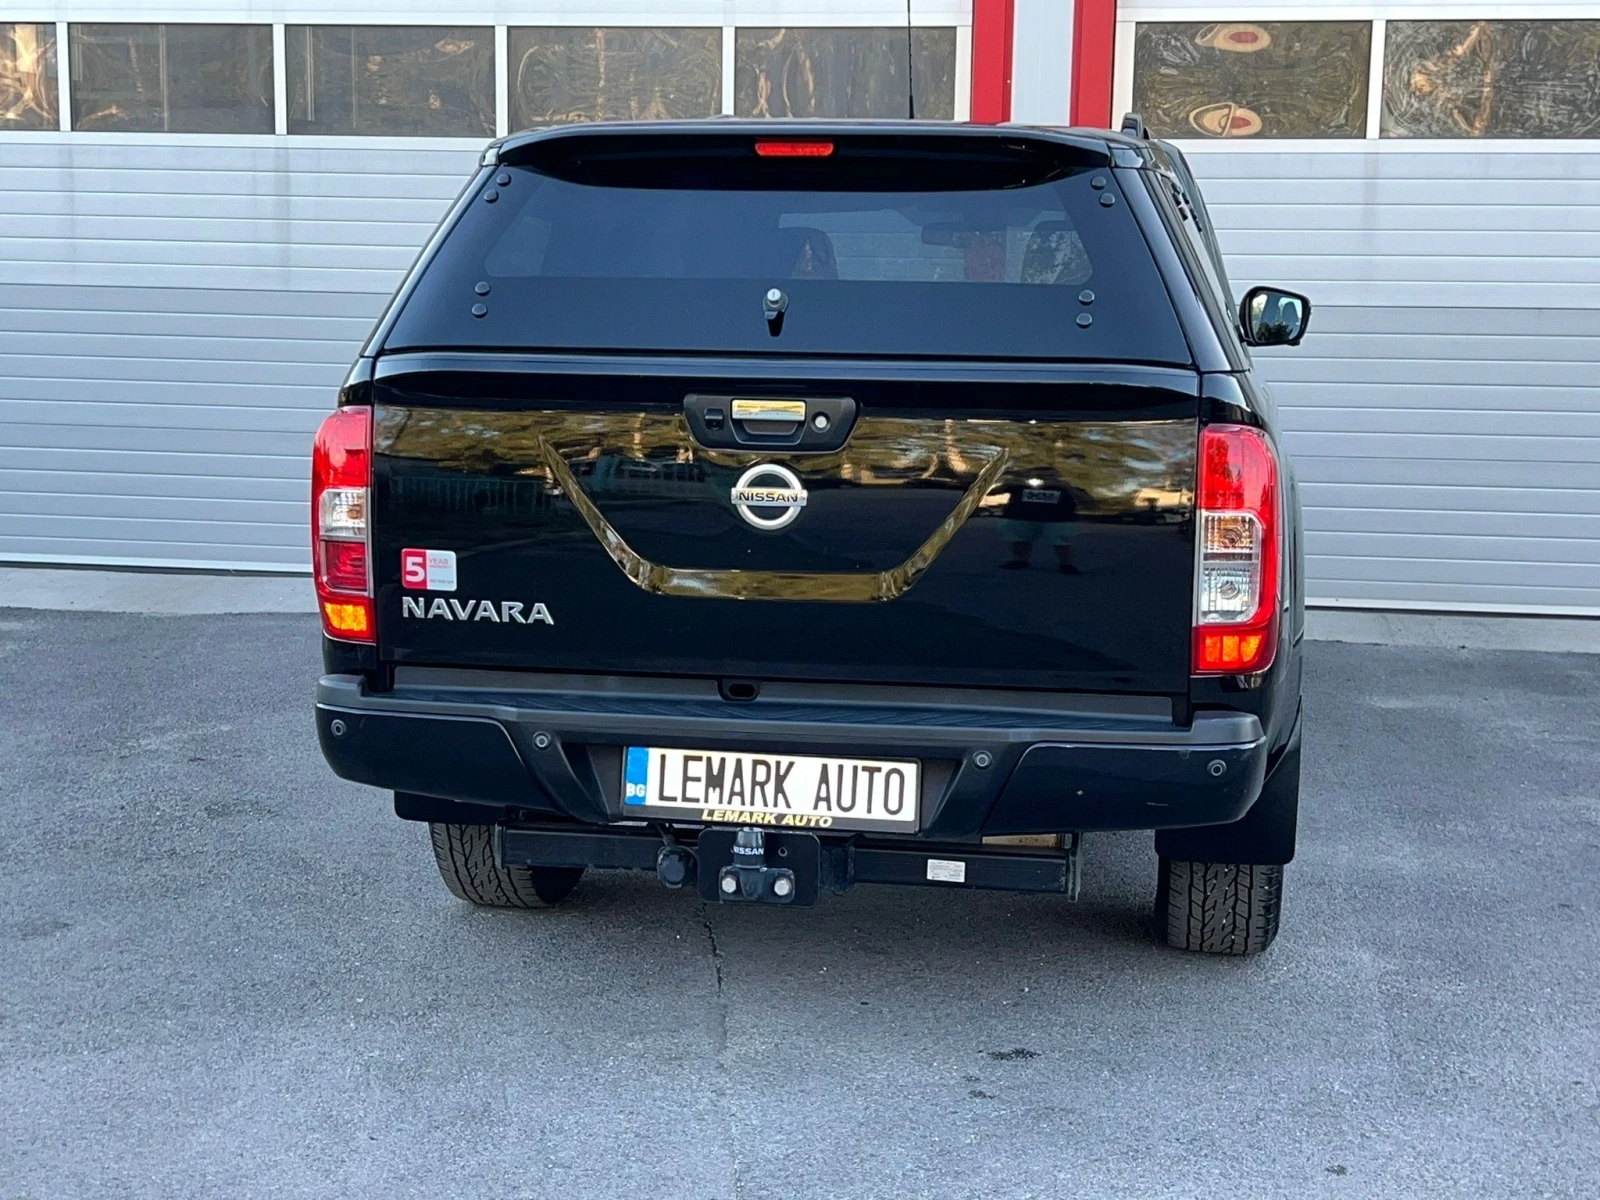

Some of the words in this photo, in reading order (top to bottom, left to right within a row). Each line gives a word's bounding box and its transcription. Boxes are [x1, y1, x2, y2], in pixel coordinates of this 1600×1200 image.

[739, 492, 799, 503] NISSAN
[405, 556, 425, 582] 5
[428, 557, 449, 566] YEAR
[402, 596, 555, 625] NAVARA
[626, 782, 646, 798] BG
[658, 753, 796, 809] LEMARK
[812, 763, 906, 816] AUTO
[701, 808, 780, 826] LEMARK
[780, 813, 833, 828] AUTO
